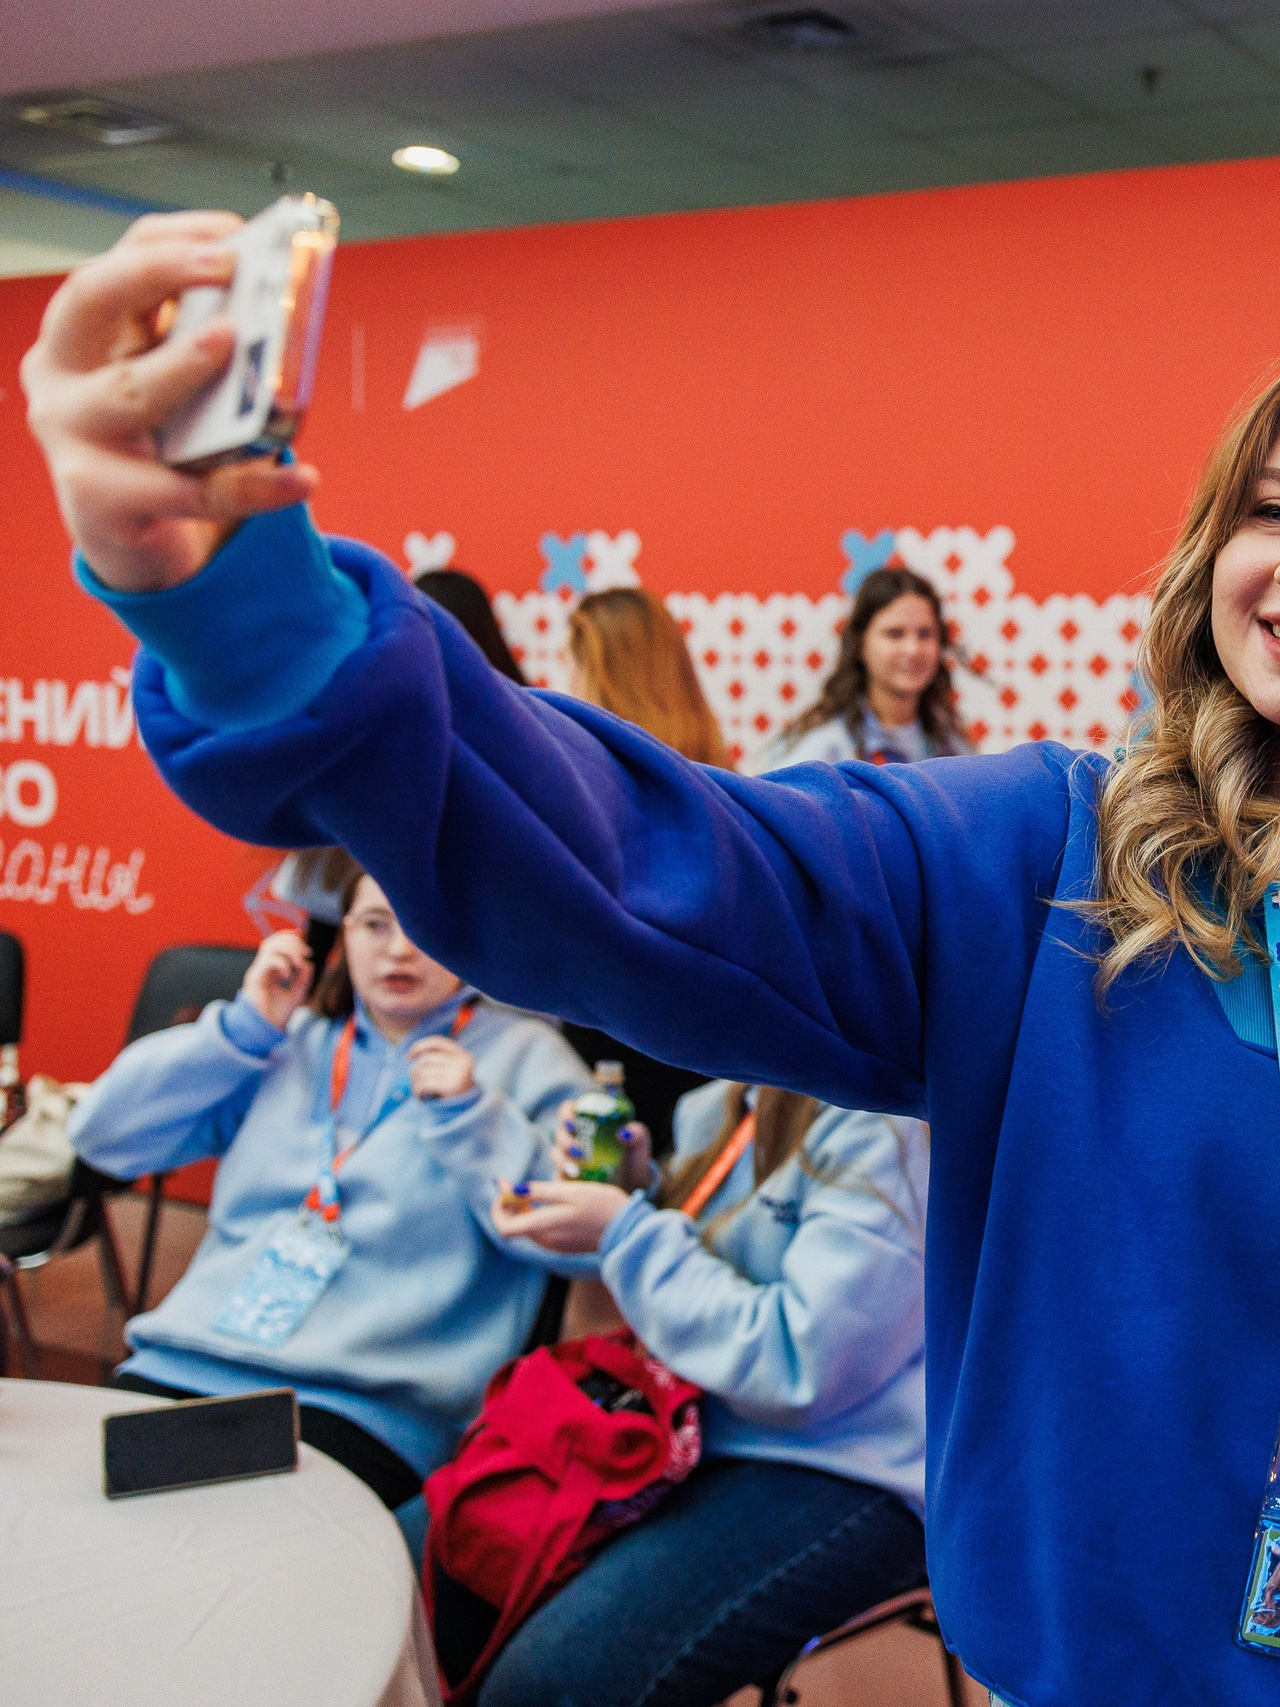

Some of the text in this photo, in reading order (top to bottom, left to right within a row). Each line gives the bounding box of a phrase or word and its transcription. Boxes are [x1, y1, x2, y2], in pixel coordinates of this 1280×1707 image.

[0, 665, 147, 750] НИЙ
[0, 759, 57, 827] О
[0, 839, 154, 914] аны
